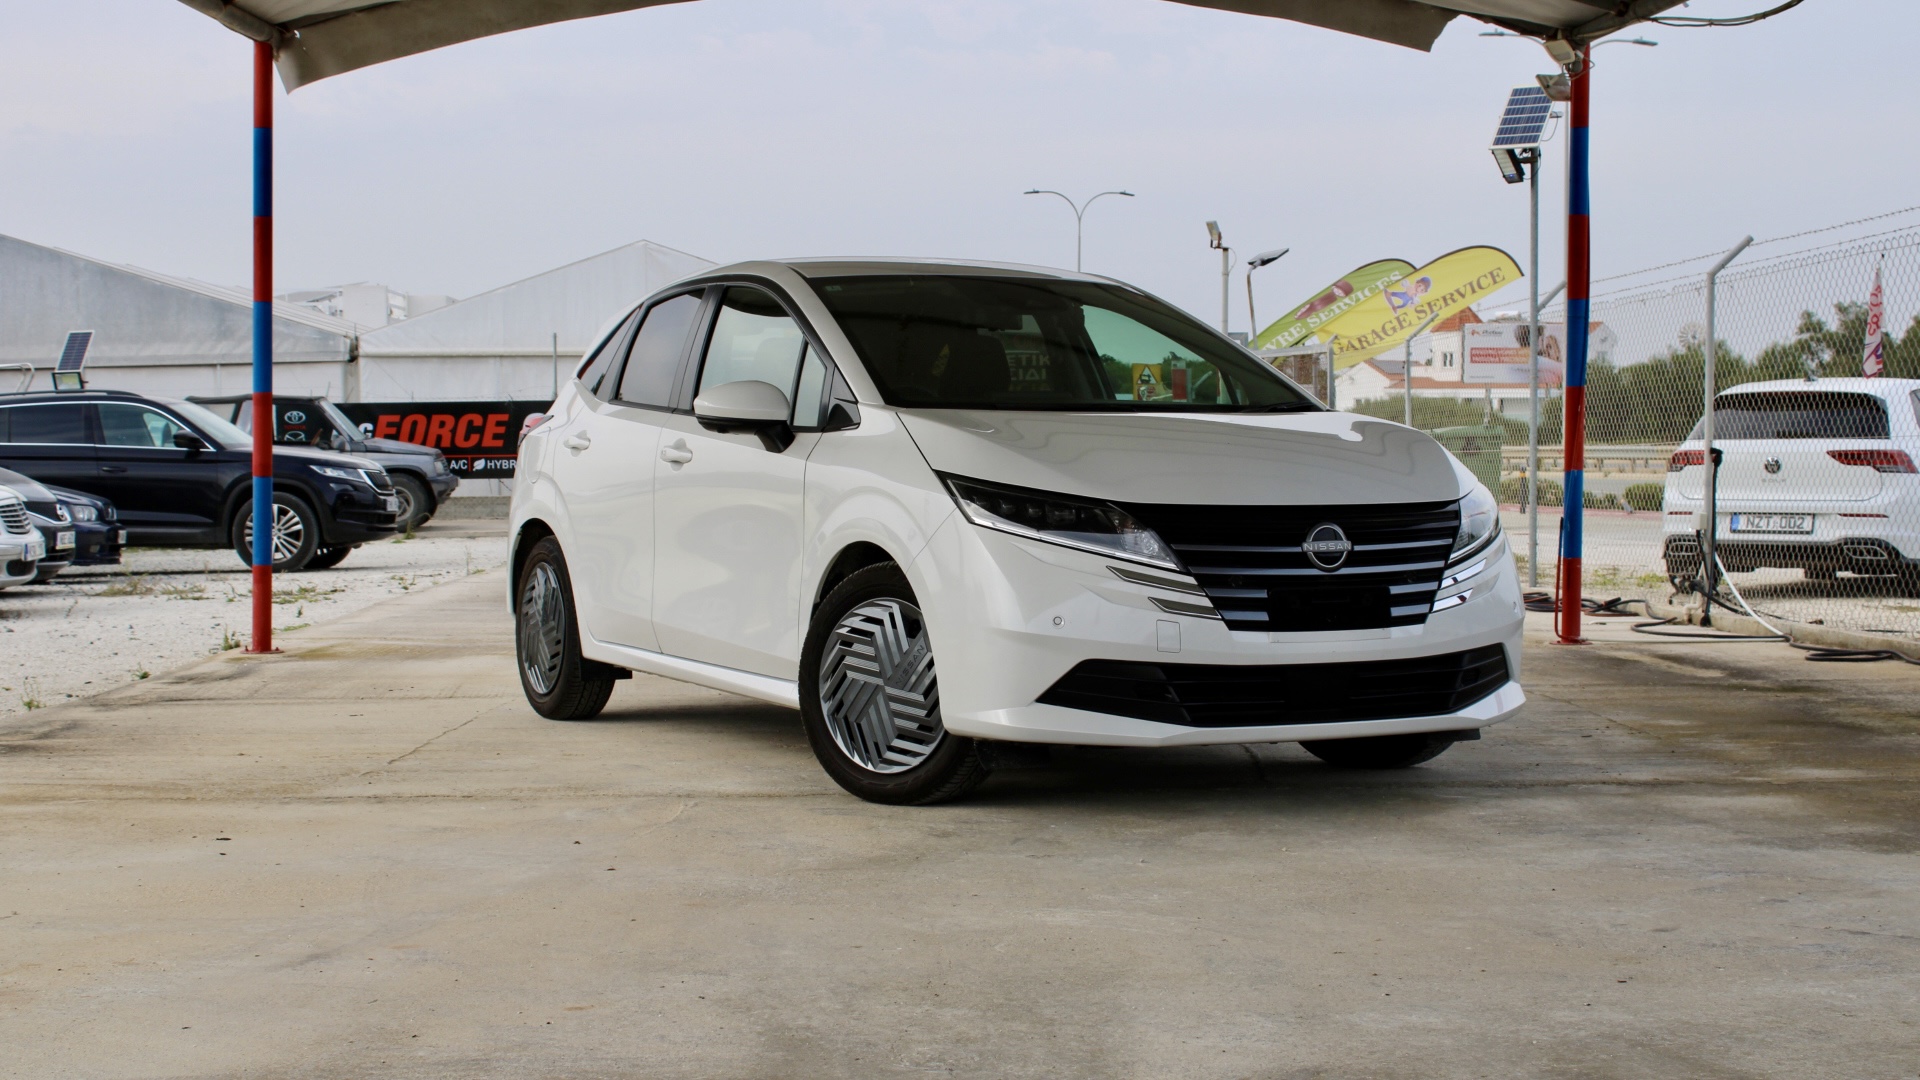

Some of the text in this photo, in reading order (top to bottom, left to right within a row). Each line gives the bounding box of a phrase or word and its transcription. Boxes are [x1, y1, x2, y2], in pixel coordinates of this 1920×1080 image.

[1414, 267, 1505, 321] SERVICE
[1261, 323, 1306, 351] YRE
[374, 413, 510, 448] FORCE
[449, 459, 468, 469] A/C
[1746, 515, 1805, 529] NZT 002
[1304, 543, 1351, 551] NISSAN
[896, 645, 924, 684] NISSAN
